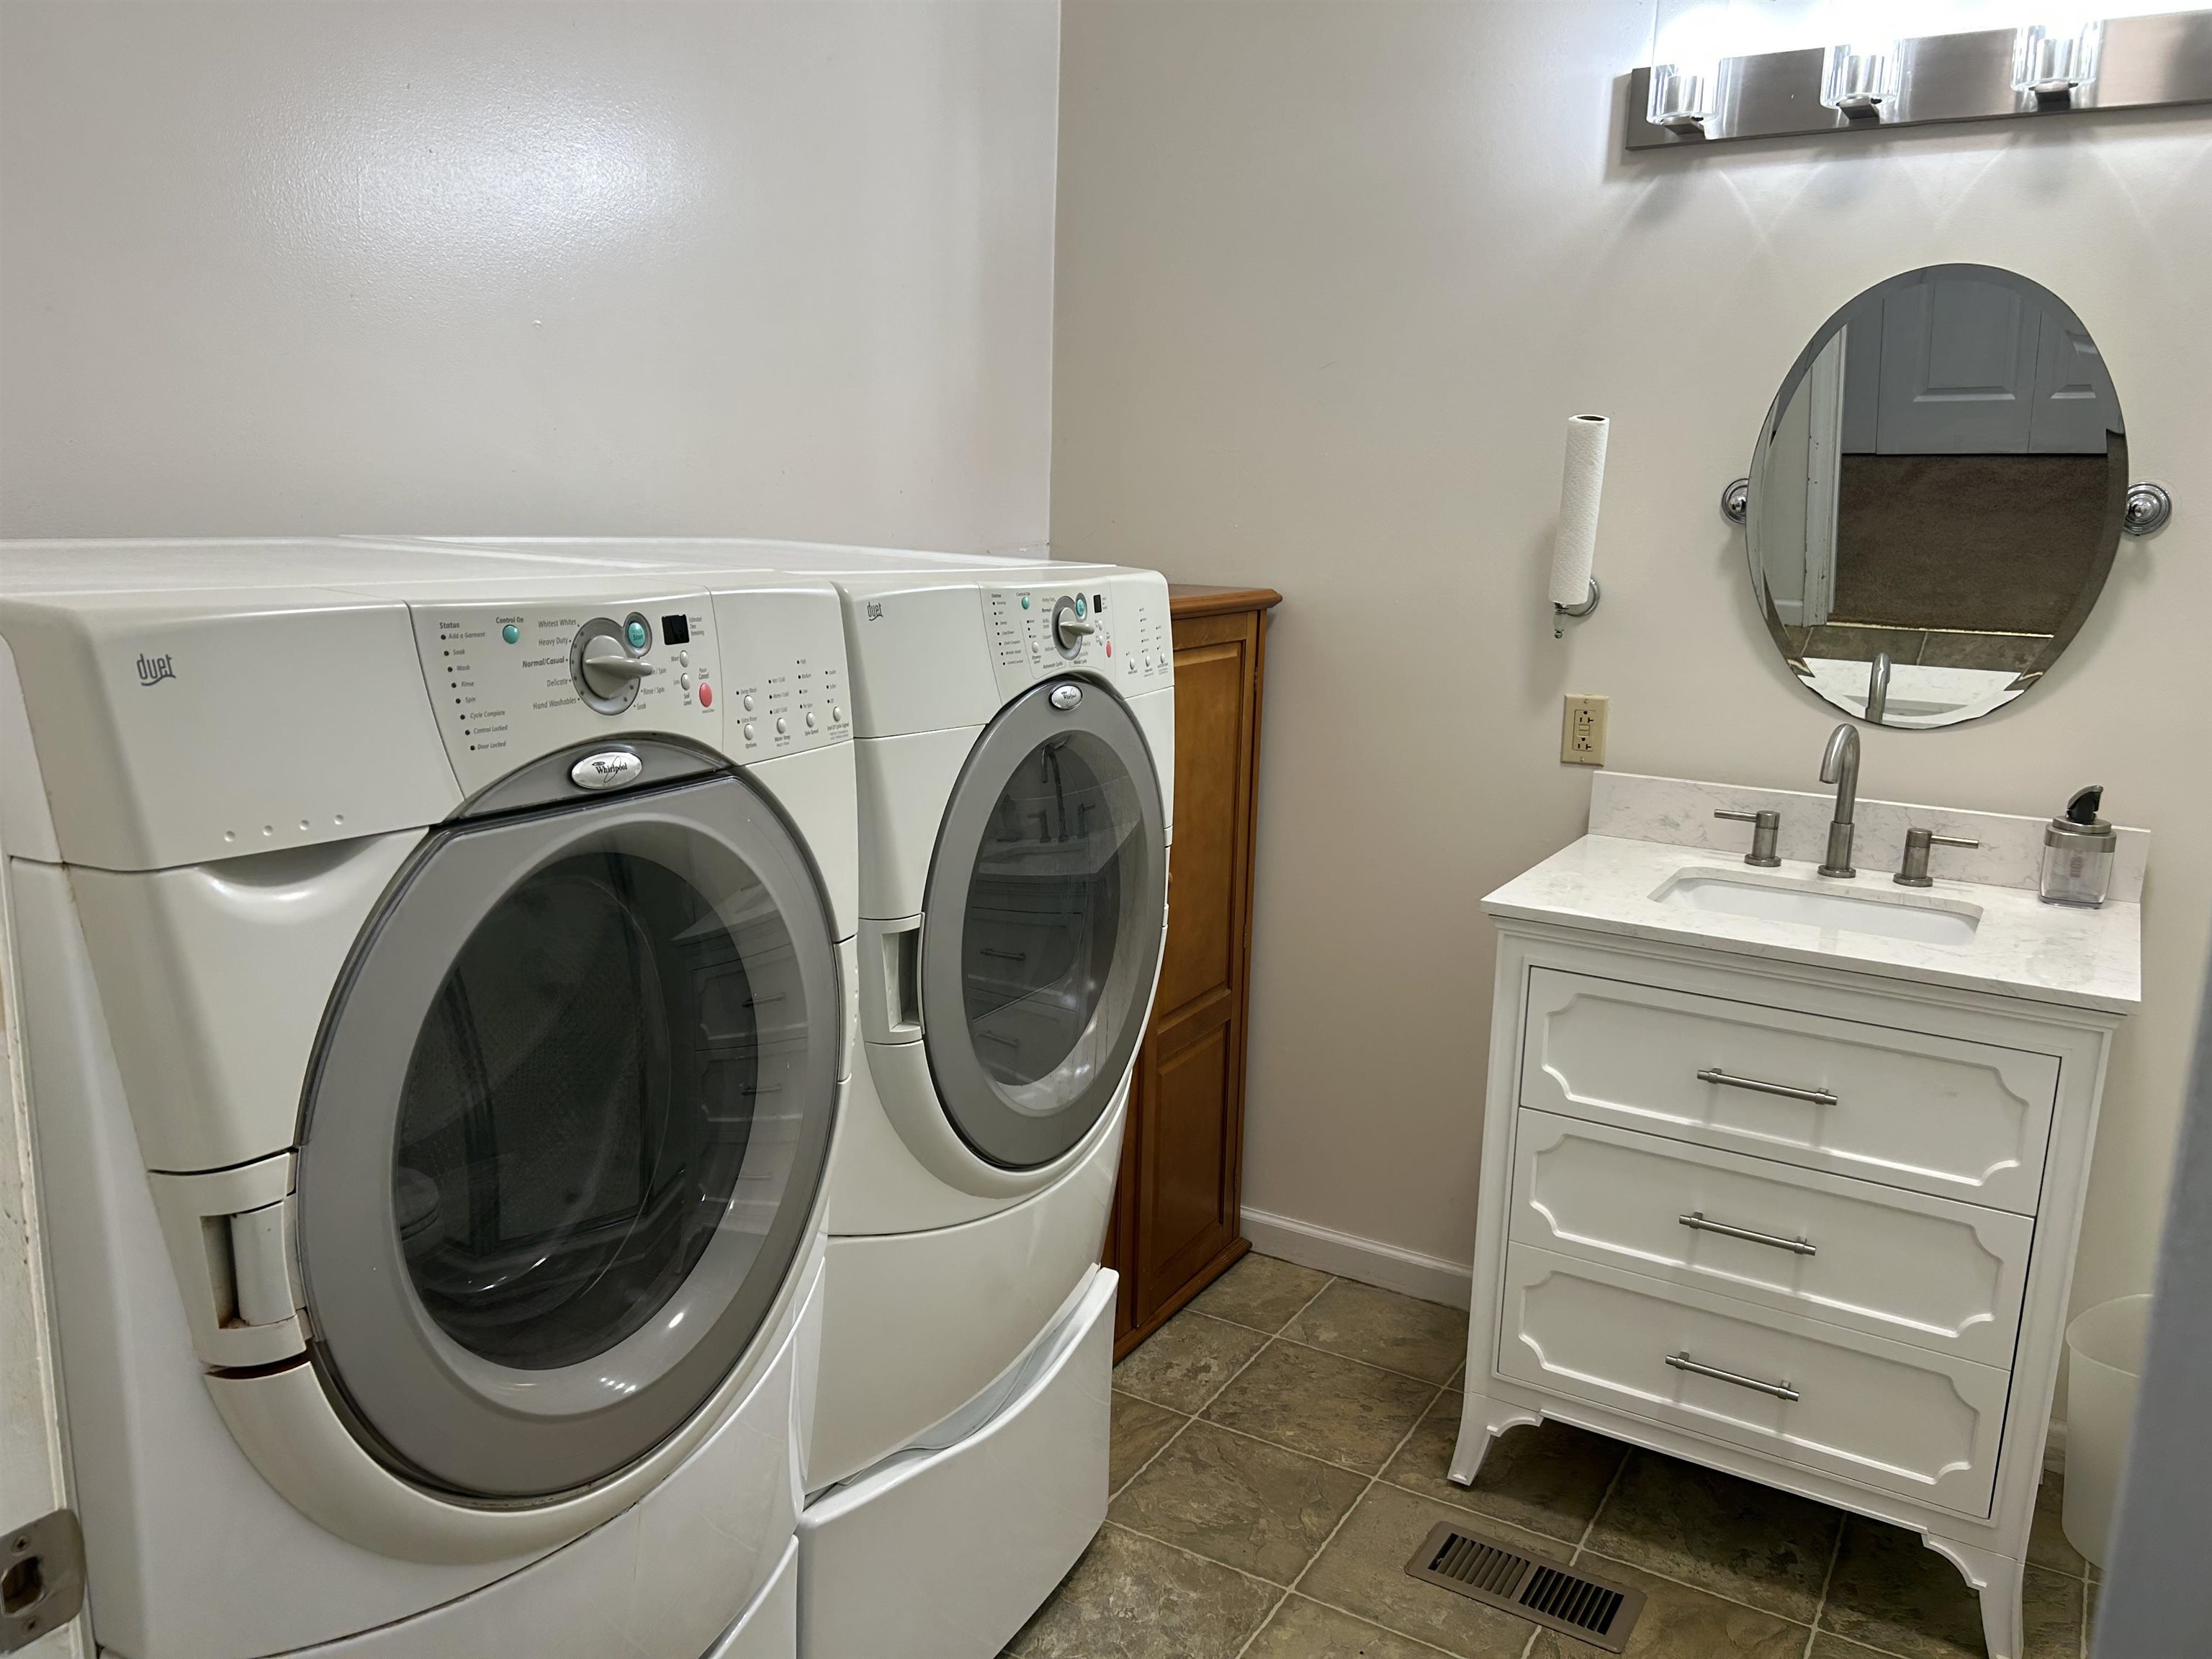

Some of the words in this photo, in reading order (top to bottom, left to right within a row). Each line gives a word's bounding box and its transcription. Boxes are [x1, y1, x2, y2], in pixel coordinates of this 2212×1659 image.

[867, 601, 883, 619] duet
[137, 653, 175, 684] duet
[547, 678, 568, 687] Delicate
[533, 701, 548, 710] Hand
[549, 697, 577, 708] Washables
[595, 763, 628, 775] Whirlpool
